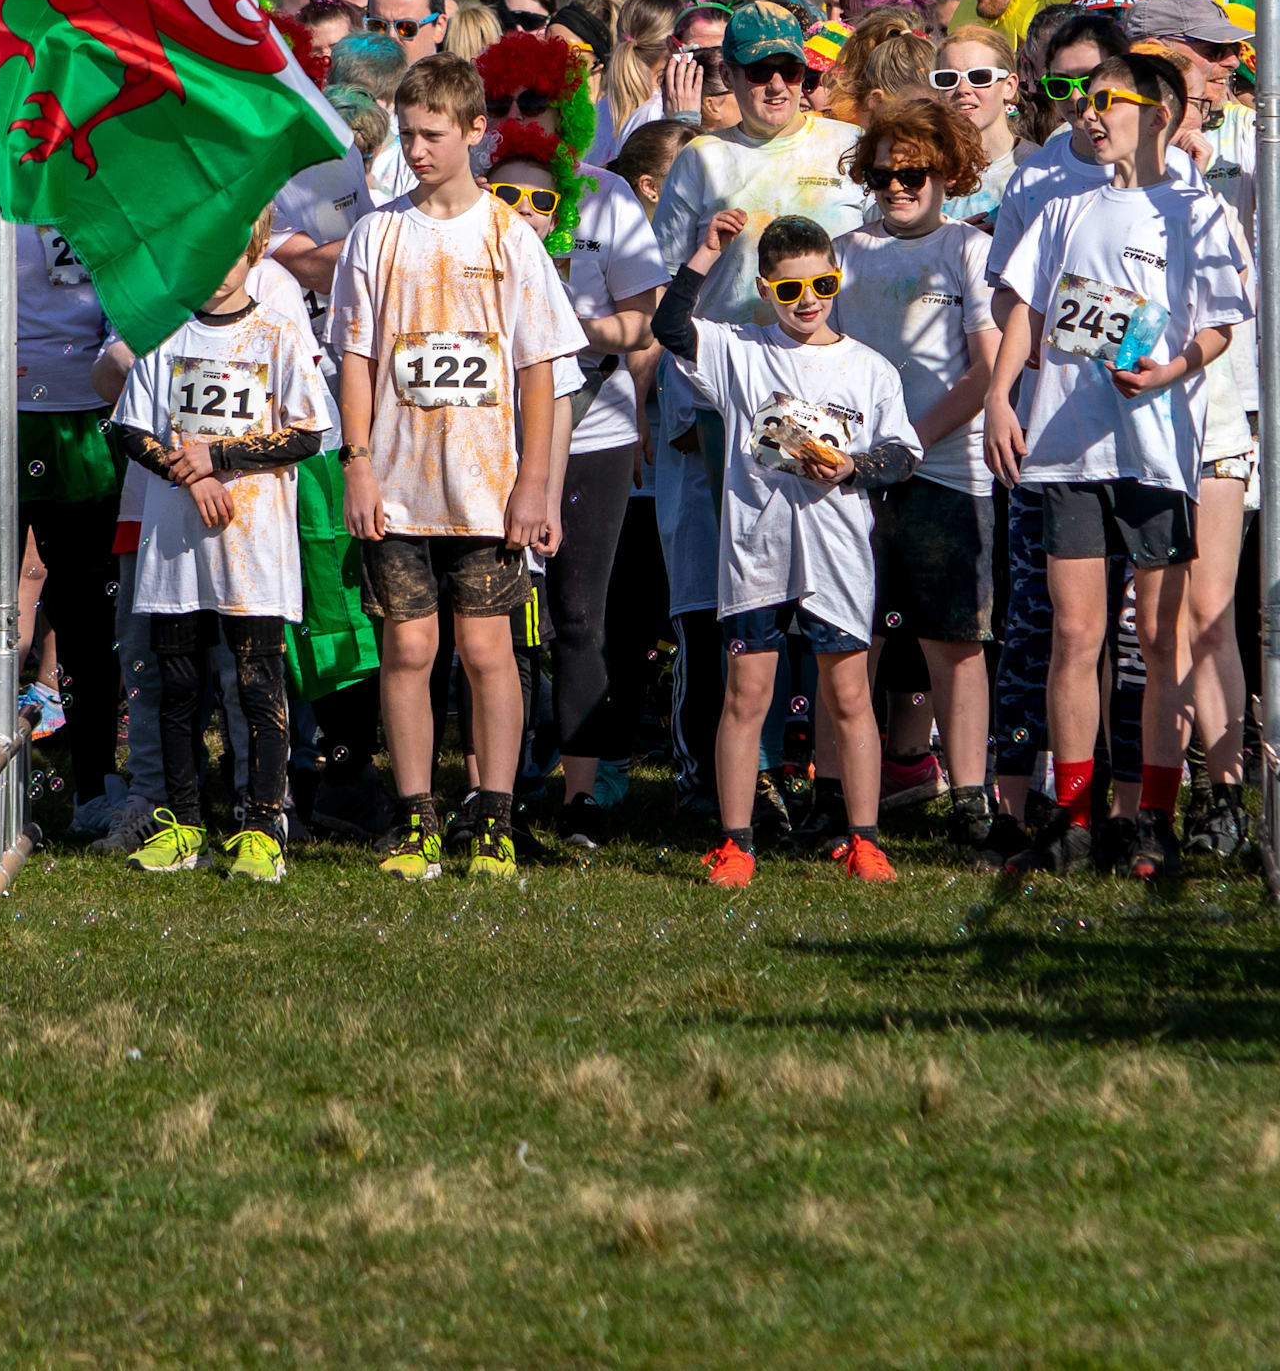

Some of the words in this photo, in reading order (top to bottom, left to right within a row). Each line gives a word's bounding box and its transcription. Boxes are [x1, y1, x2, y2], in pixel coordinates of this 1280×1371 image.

[1123, 251, 1154, 264] CYMRU
[921, 296, 953, 306] CYMRU
[1056, 299, 1131, 345] 243
[407, 355, 488, 389] 122
[179, 382, 255, 420] 121
